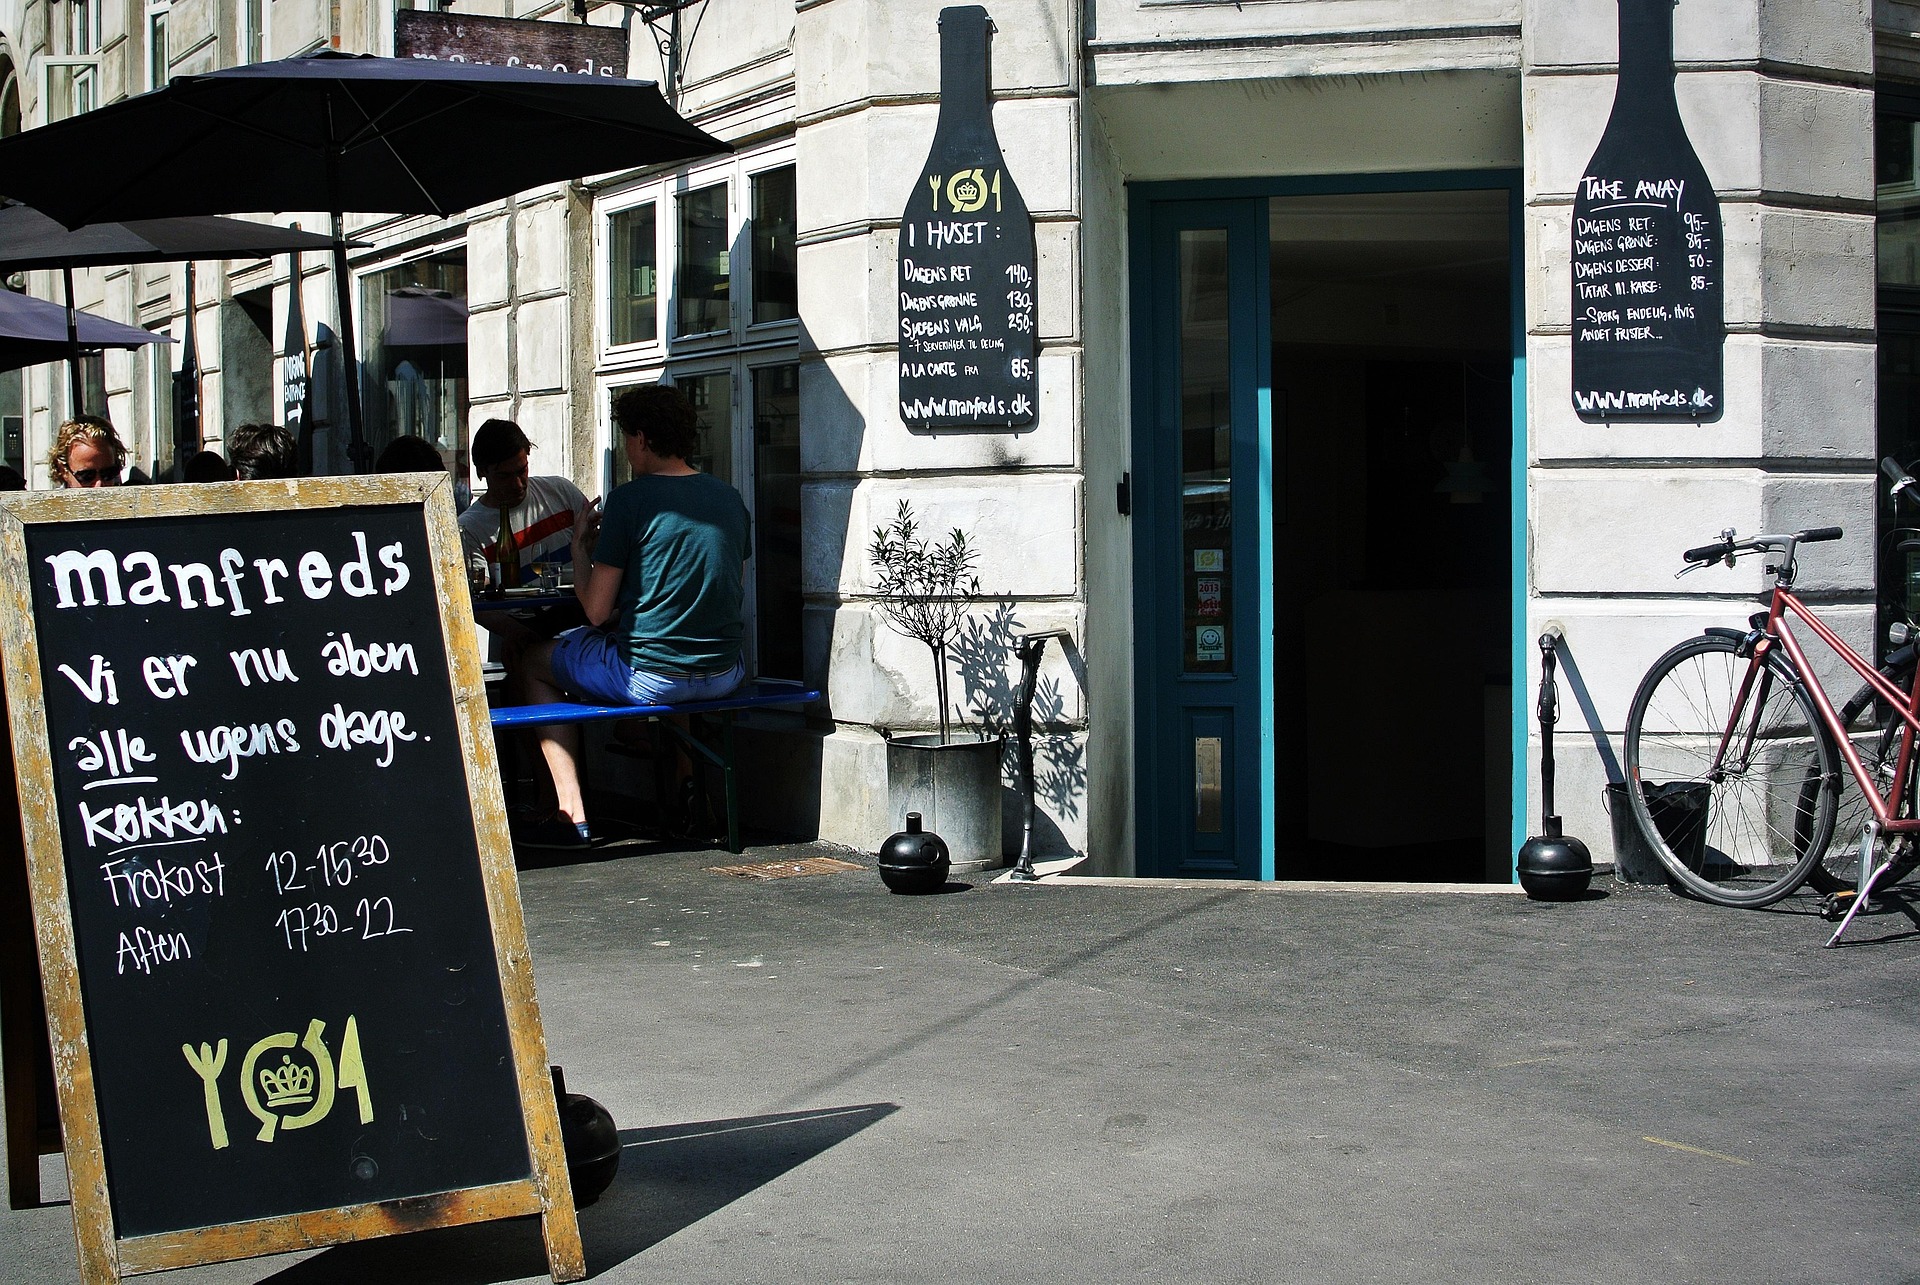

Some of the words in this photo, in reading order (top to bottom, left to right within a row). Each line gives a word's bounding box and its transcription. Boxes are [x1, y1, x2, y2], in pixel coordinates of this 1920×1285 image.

[1581, 176, 1627, 200] TAKE
[1635, 178, 1685, 212] AWAY
[908, 222, 915, 247] I
[1577, 217, 1621, 237] DAGENS
[1629, 216, 1655, 231] RET:
[1575, 238, 1613, 256] DAGENS
[904, 258, 947, 284] DAGENS
[950, 265, 972, 282] RET
[1575, 260, 1613, 279] DAGENS
[1615, 256, 1660, 273] DESSERT:
[1576, 282, 1612, 299] TATAR
[900, 291, 937, 312] DAGENS
[954, 314, 982, 333] VALG
[923, 339, 966, 352] SERVERINGER
[968, 339, 978, 350] TIL
[980, 338, 1005, 352] DELING
[1580, 328, 1611, 341] ANDET
[901, 362, 910, 377] A
[911, 363, 926, 378] LA
[927, 361, 957, 377] CARTE
[964, 365, 979, 376] FRA
[285, 381, 306, 402] ENTRANCE
[45, 531, 411, 616] manfreds
[1199, 583, 1220, 593] 2013
[142, 653, 198, 699] er
[229, 647, 299, 687] nu
[321, 632, 419, 677] åben
[68, 728, 157, 777] alle
[180, 718, 300, 780] ugens
[100, 852, 226, 907] Frokost
[116, 926, 192, 975] Aften
